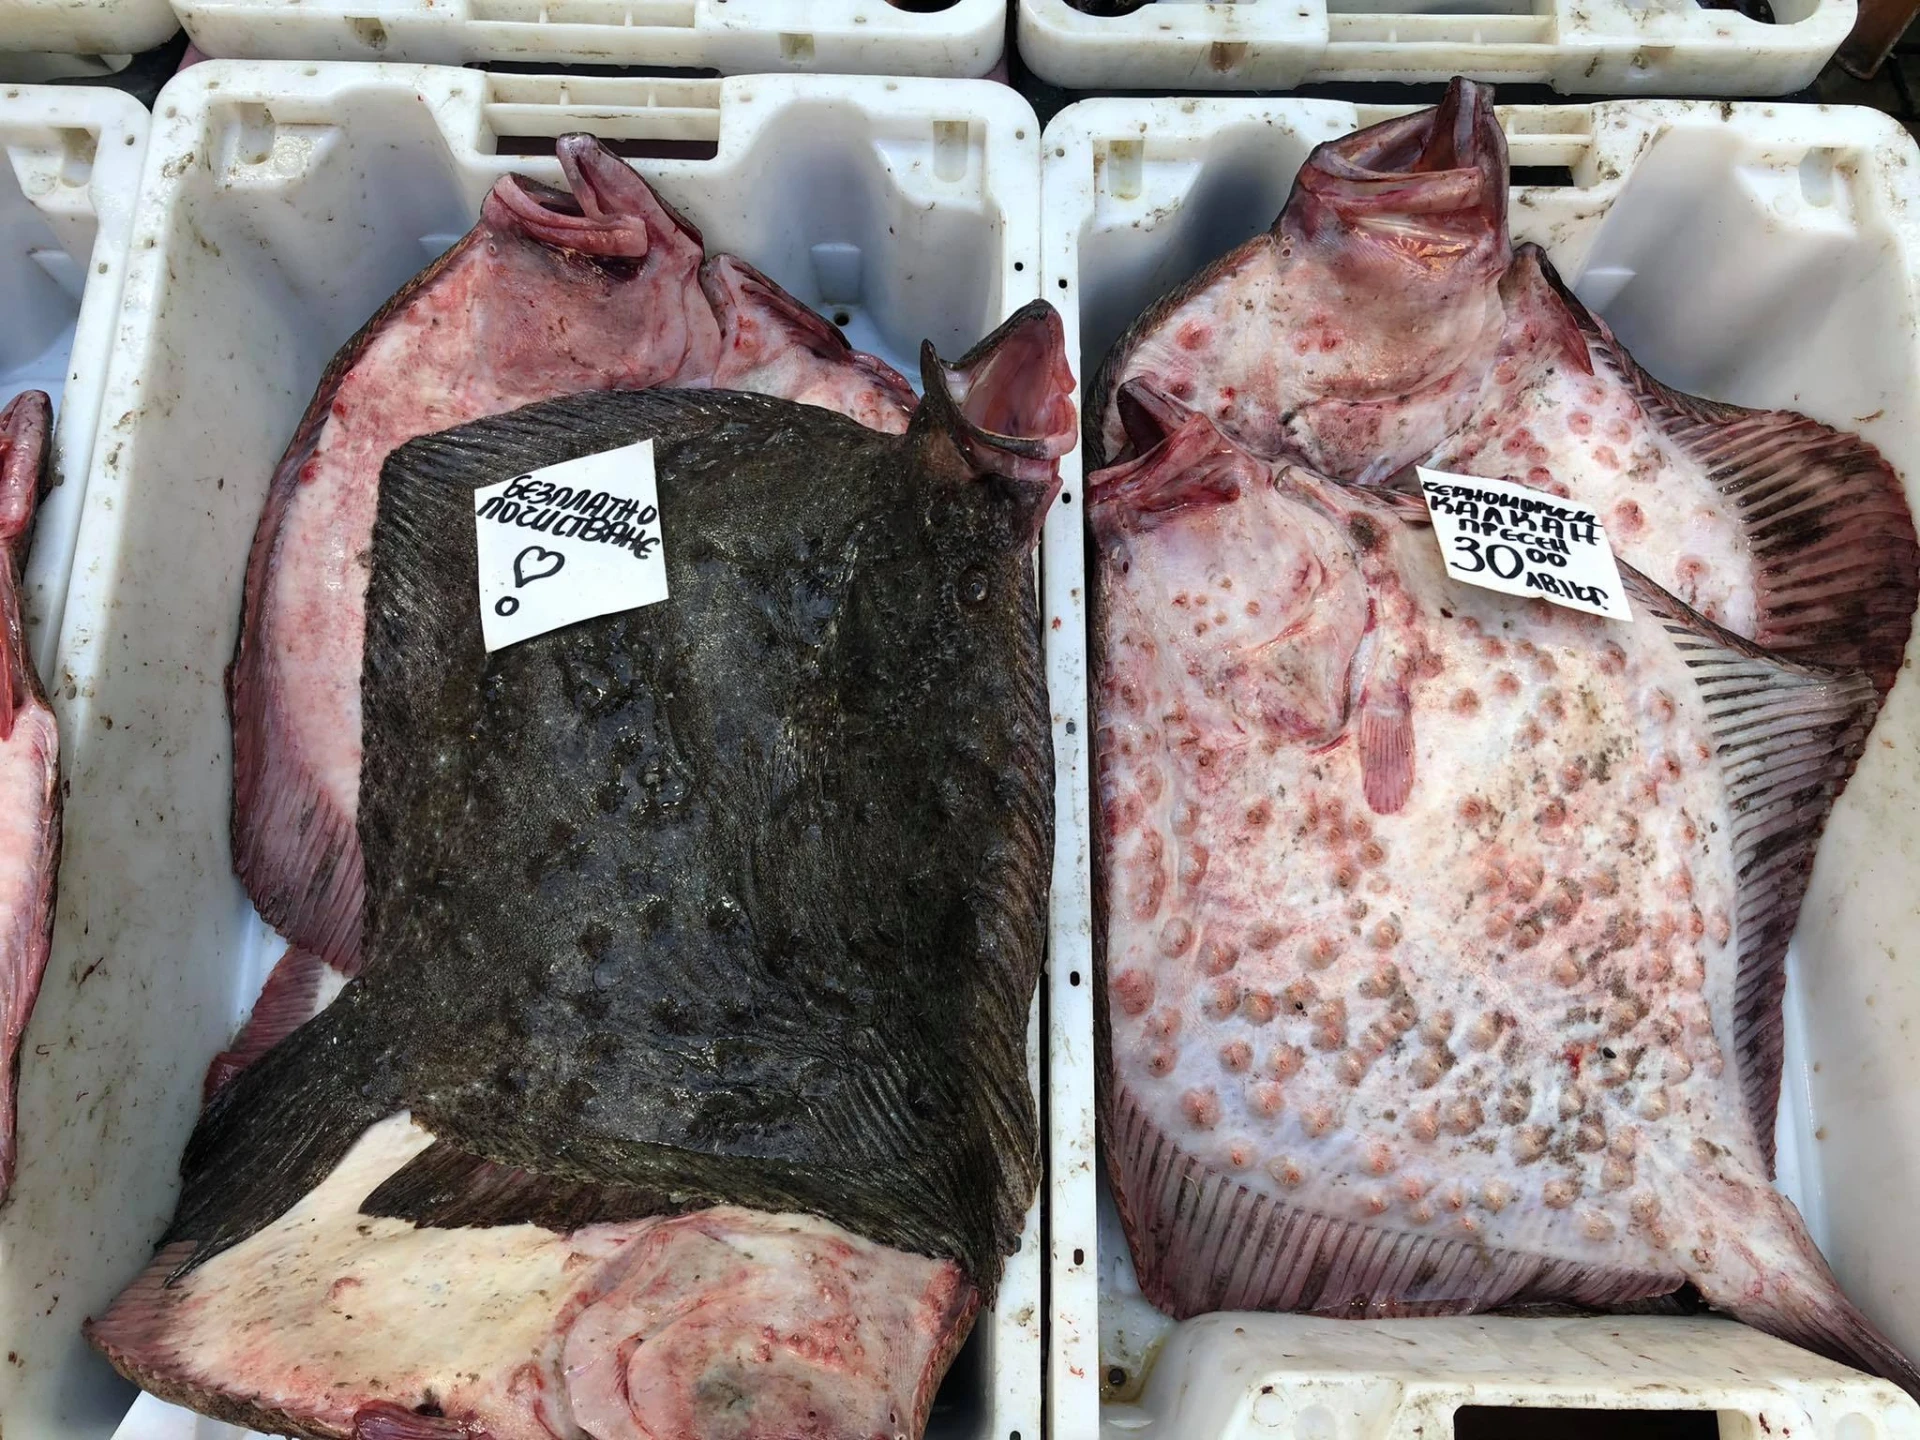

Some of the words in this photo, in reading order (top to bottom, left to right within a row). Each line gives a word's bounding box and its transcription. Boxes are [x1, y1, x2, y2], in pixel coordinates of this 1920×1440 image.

[503, 475, 657, 525] БЕЗПЛАТНО
[1430, 496, 1601, 546] КАЛКАН
[1458, 519, 1571, 555] ПРЕСЕН
